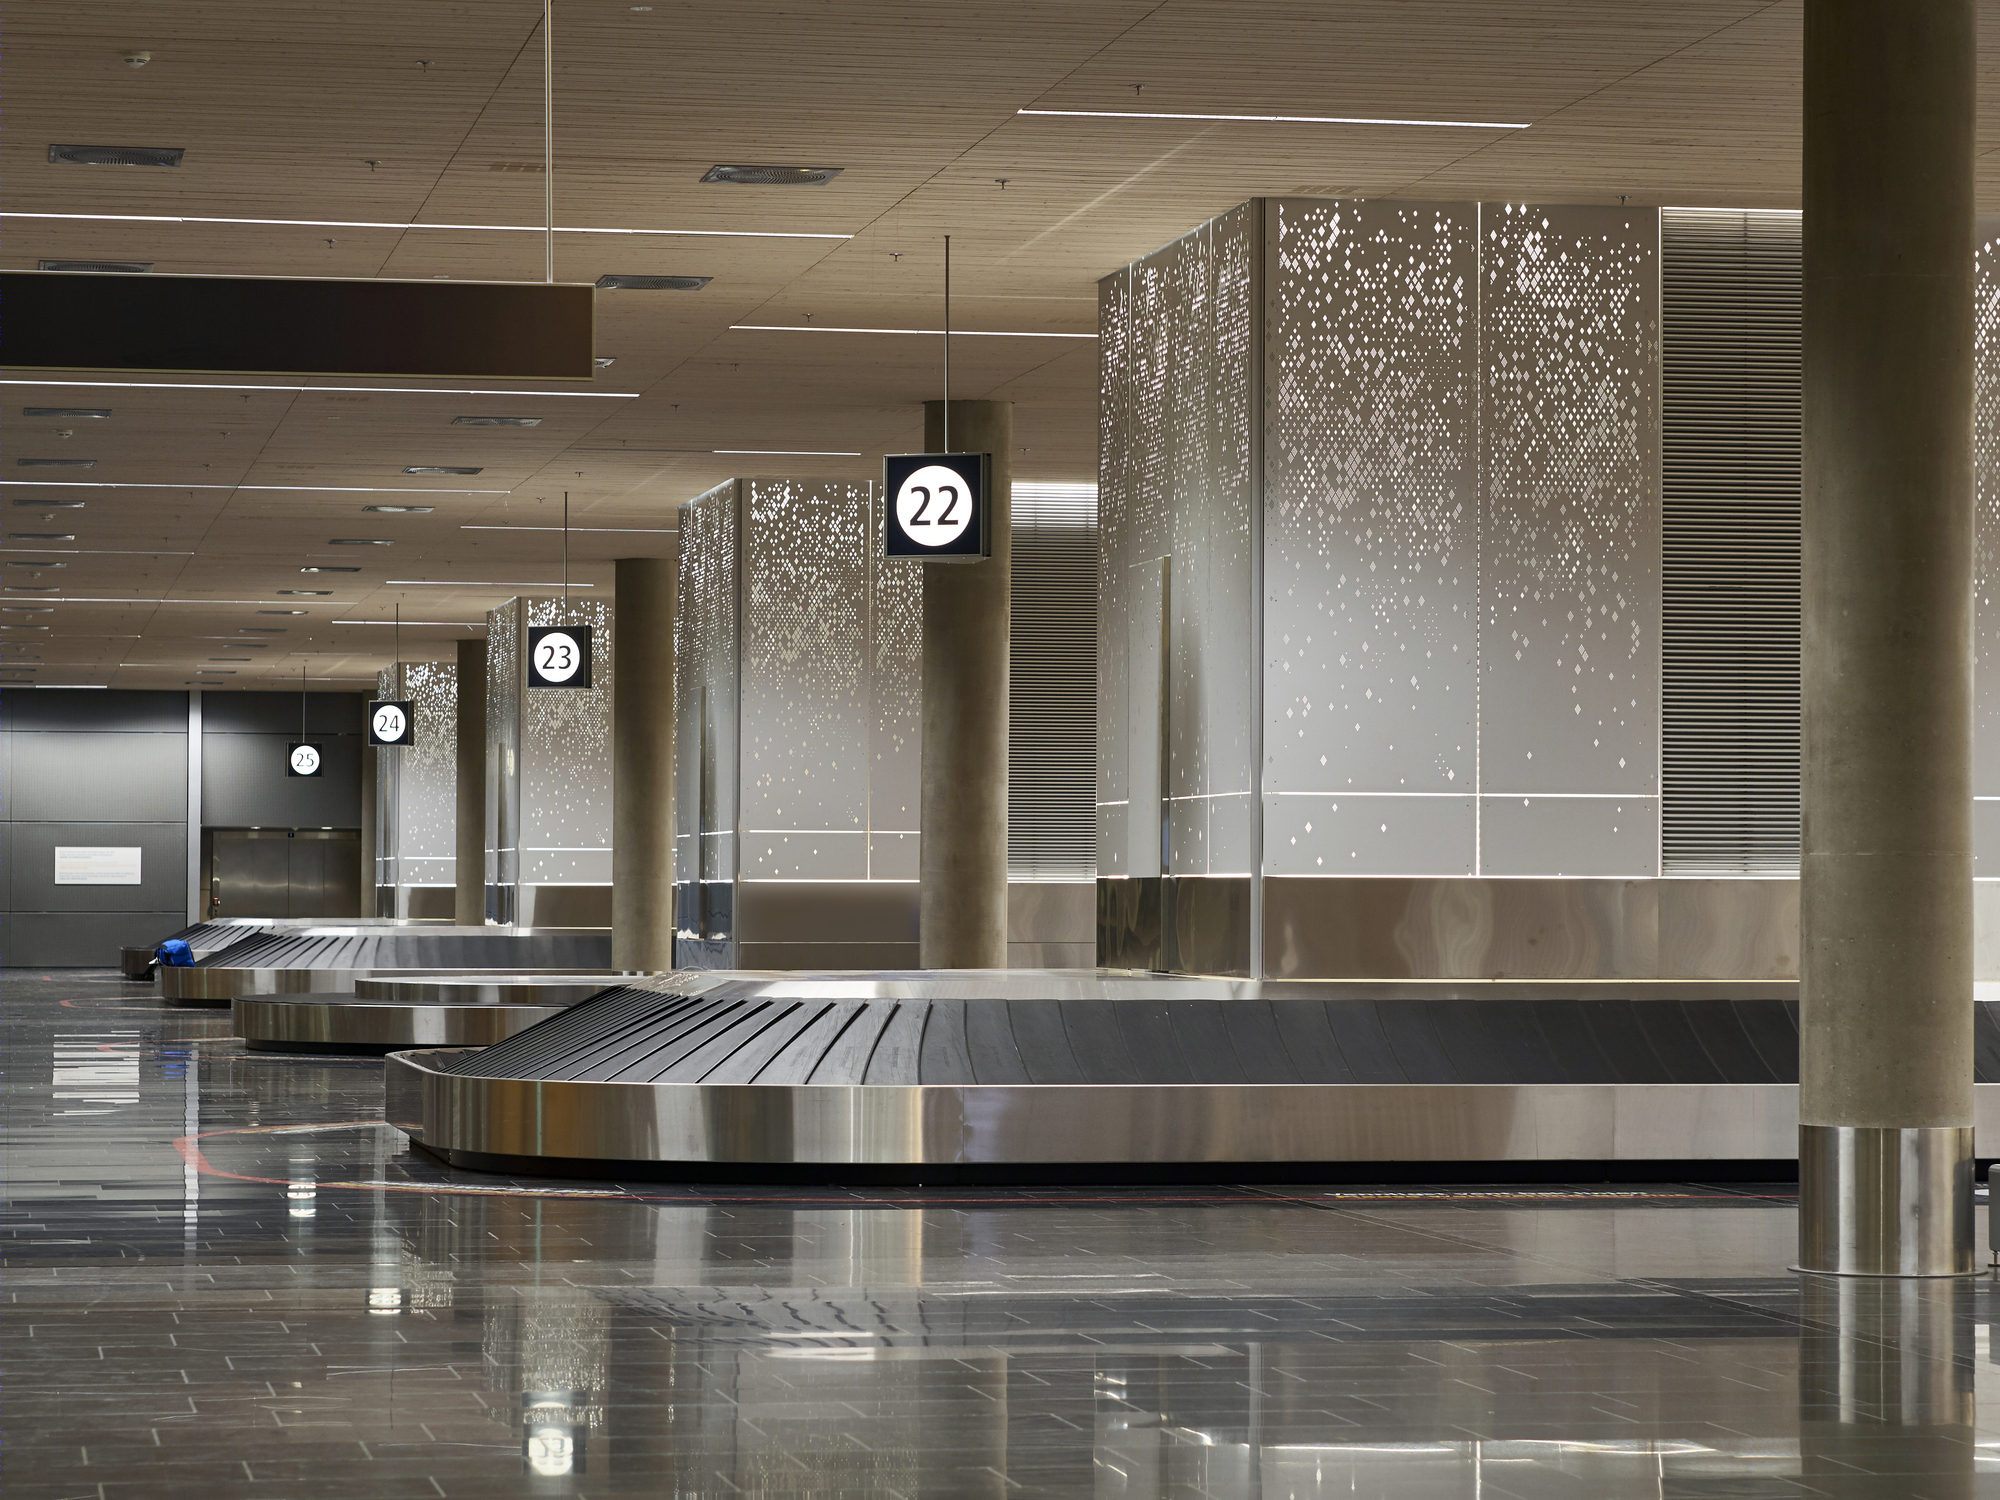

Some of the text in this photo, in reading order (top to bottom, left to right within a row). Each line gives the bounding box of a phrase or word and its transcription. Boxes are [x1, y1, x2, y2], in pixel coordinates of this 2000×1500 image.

[910, 485, 959, 526] 22
[542, 645, 571, 670] 23
[379, 714, 399, 732] 24
[296, 753, 314, 767] 25
